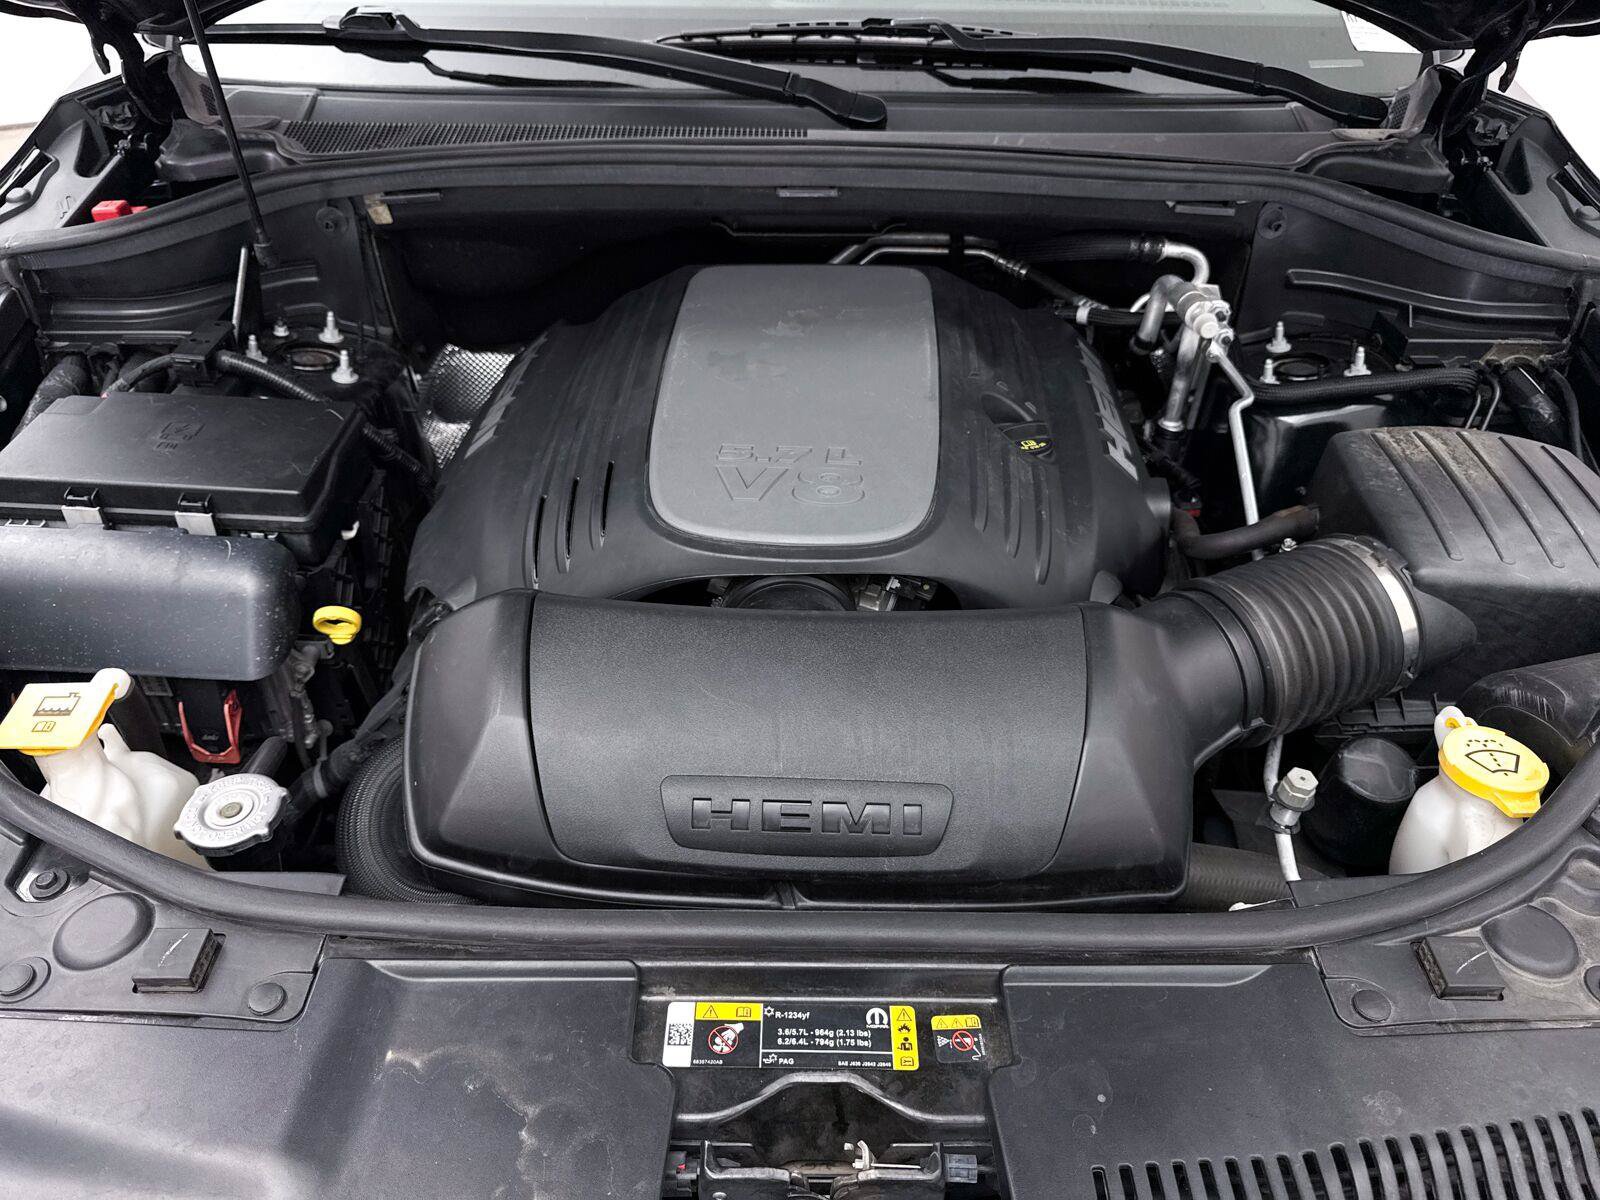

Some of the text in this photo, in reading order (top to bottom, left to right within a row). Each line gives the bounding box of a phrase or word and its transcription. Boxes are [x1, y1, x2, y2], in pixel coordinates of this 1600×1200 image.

[715, 464, 866, 506] V8
[691, 797, 923, 836] HEMI
[774, 1011, 811, 1021] R-1234yf
[777, 1028, 809, 1036] 3.6/5.7L
[836, 1029, 855, 1038] (2.13
[856, 1030, 872, 1039] lbs)
[777, 1038, 809, 1046] 6.2/6.4L
[814, 1038, 835, 1048] 794g
[836, 1038, 856, 1048] (1.75
[856, 1039, 872, 1048] lbs)
